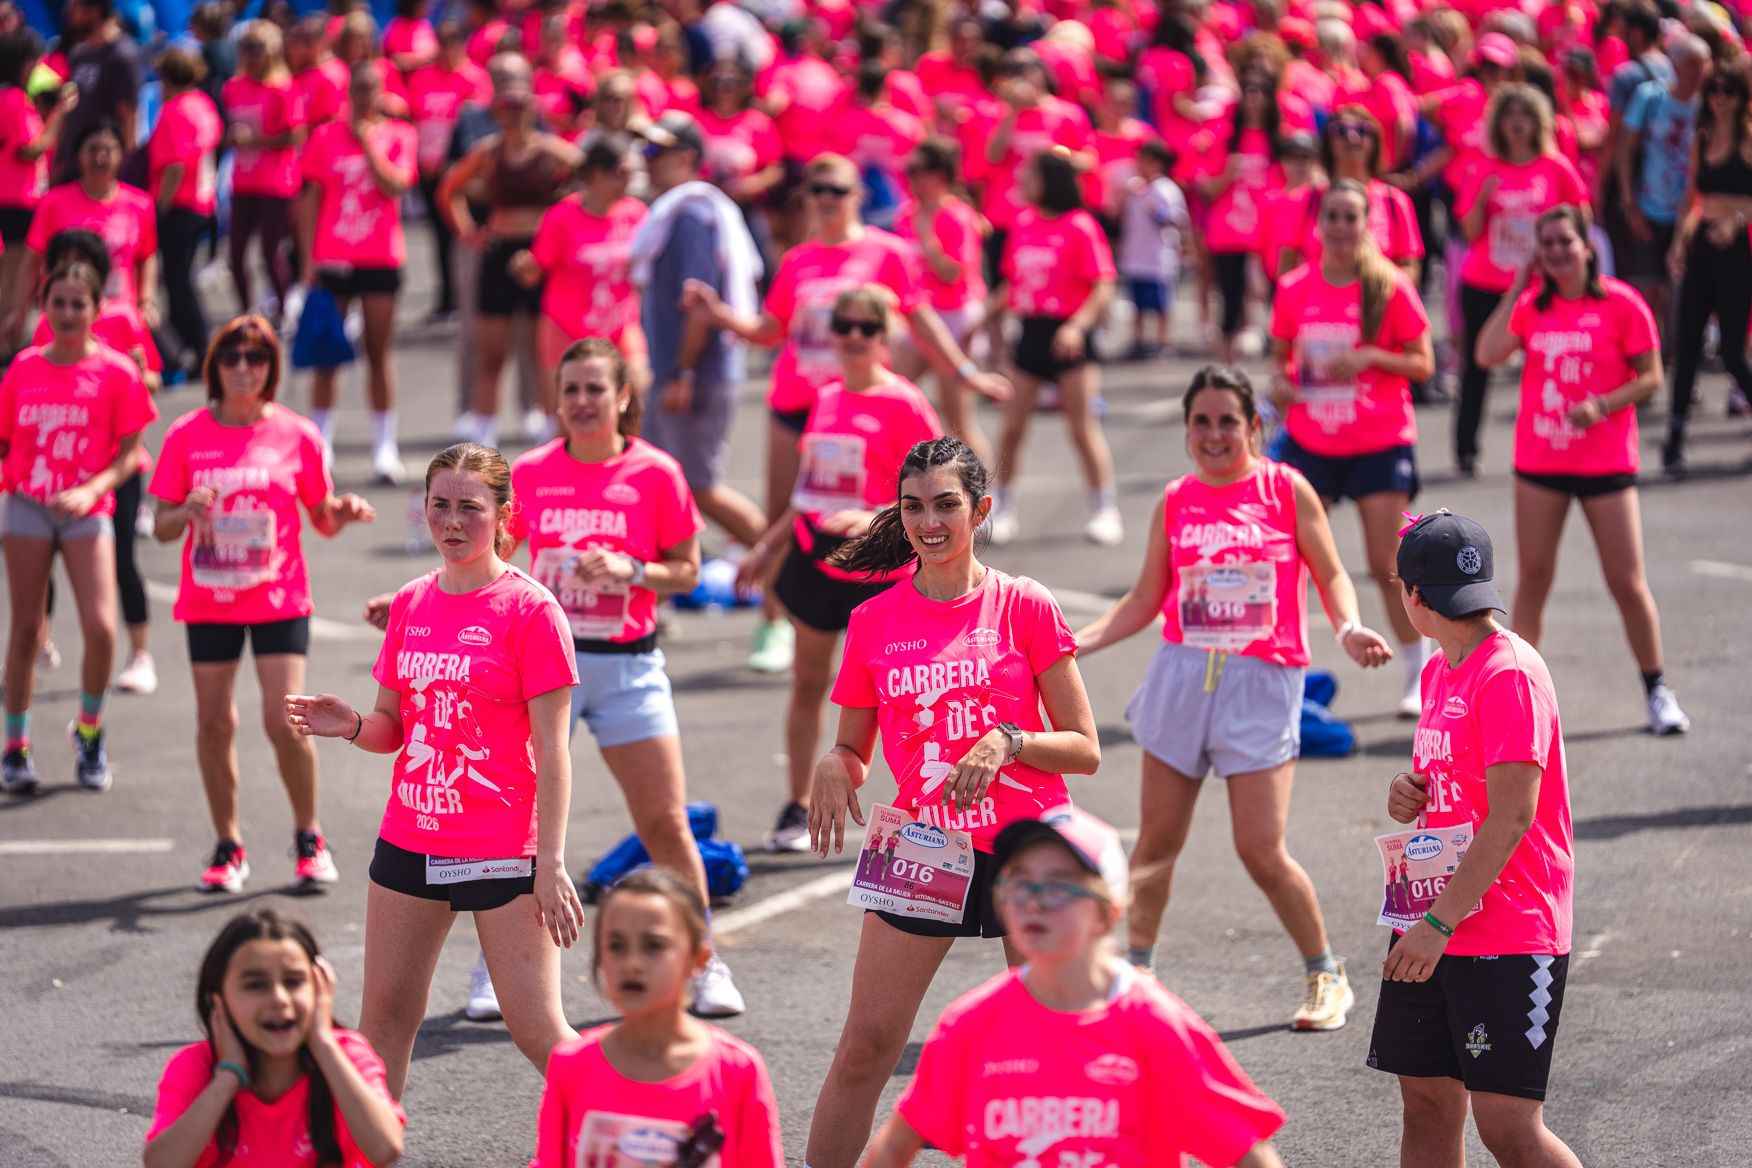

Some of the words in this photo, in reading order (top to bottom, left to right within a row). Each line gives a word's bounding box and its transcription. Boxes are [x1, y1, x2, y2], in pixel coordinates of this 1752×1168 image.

[539, 508, 628, 538] CARRERA
[1208, 601, 1246, 618] 016
[405, 626, 431, 637] YSHO
[885, 639, 927, 655] OYSHO
[888, 658, 991, 698] CARRERA
[434, 689, 457, 729] DE
[945, 699, 979, 741] DE
[426, 750, 446, 785] LA
[1426, 770, 1453, 812] DE
[416, 814, 439, 831] 2026
[880, 815, 901, 826] SUMA
[904, 828, 945, 845] ASTURIANA
[1387, 843, 1403, 851] SUMA
[1408, 845, 1440, 856] ASTURIANA
[440, 868, 471, 878] OYSHO
[892, 859, 935, 883] 016
[856, 880, 878, 889] CARRERA
[893, 888, 911, 898] MUJER
[904, 881, 914, 890] 86
[1411, 877, 1446, 899] 016
[860, 893, 894, 908] OYSHO
[915, 906, 950, 917] Santander
[1384, 911, 1409, 920] CARRERA
[984, 1096, 1120, 1140] CARRERA
